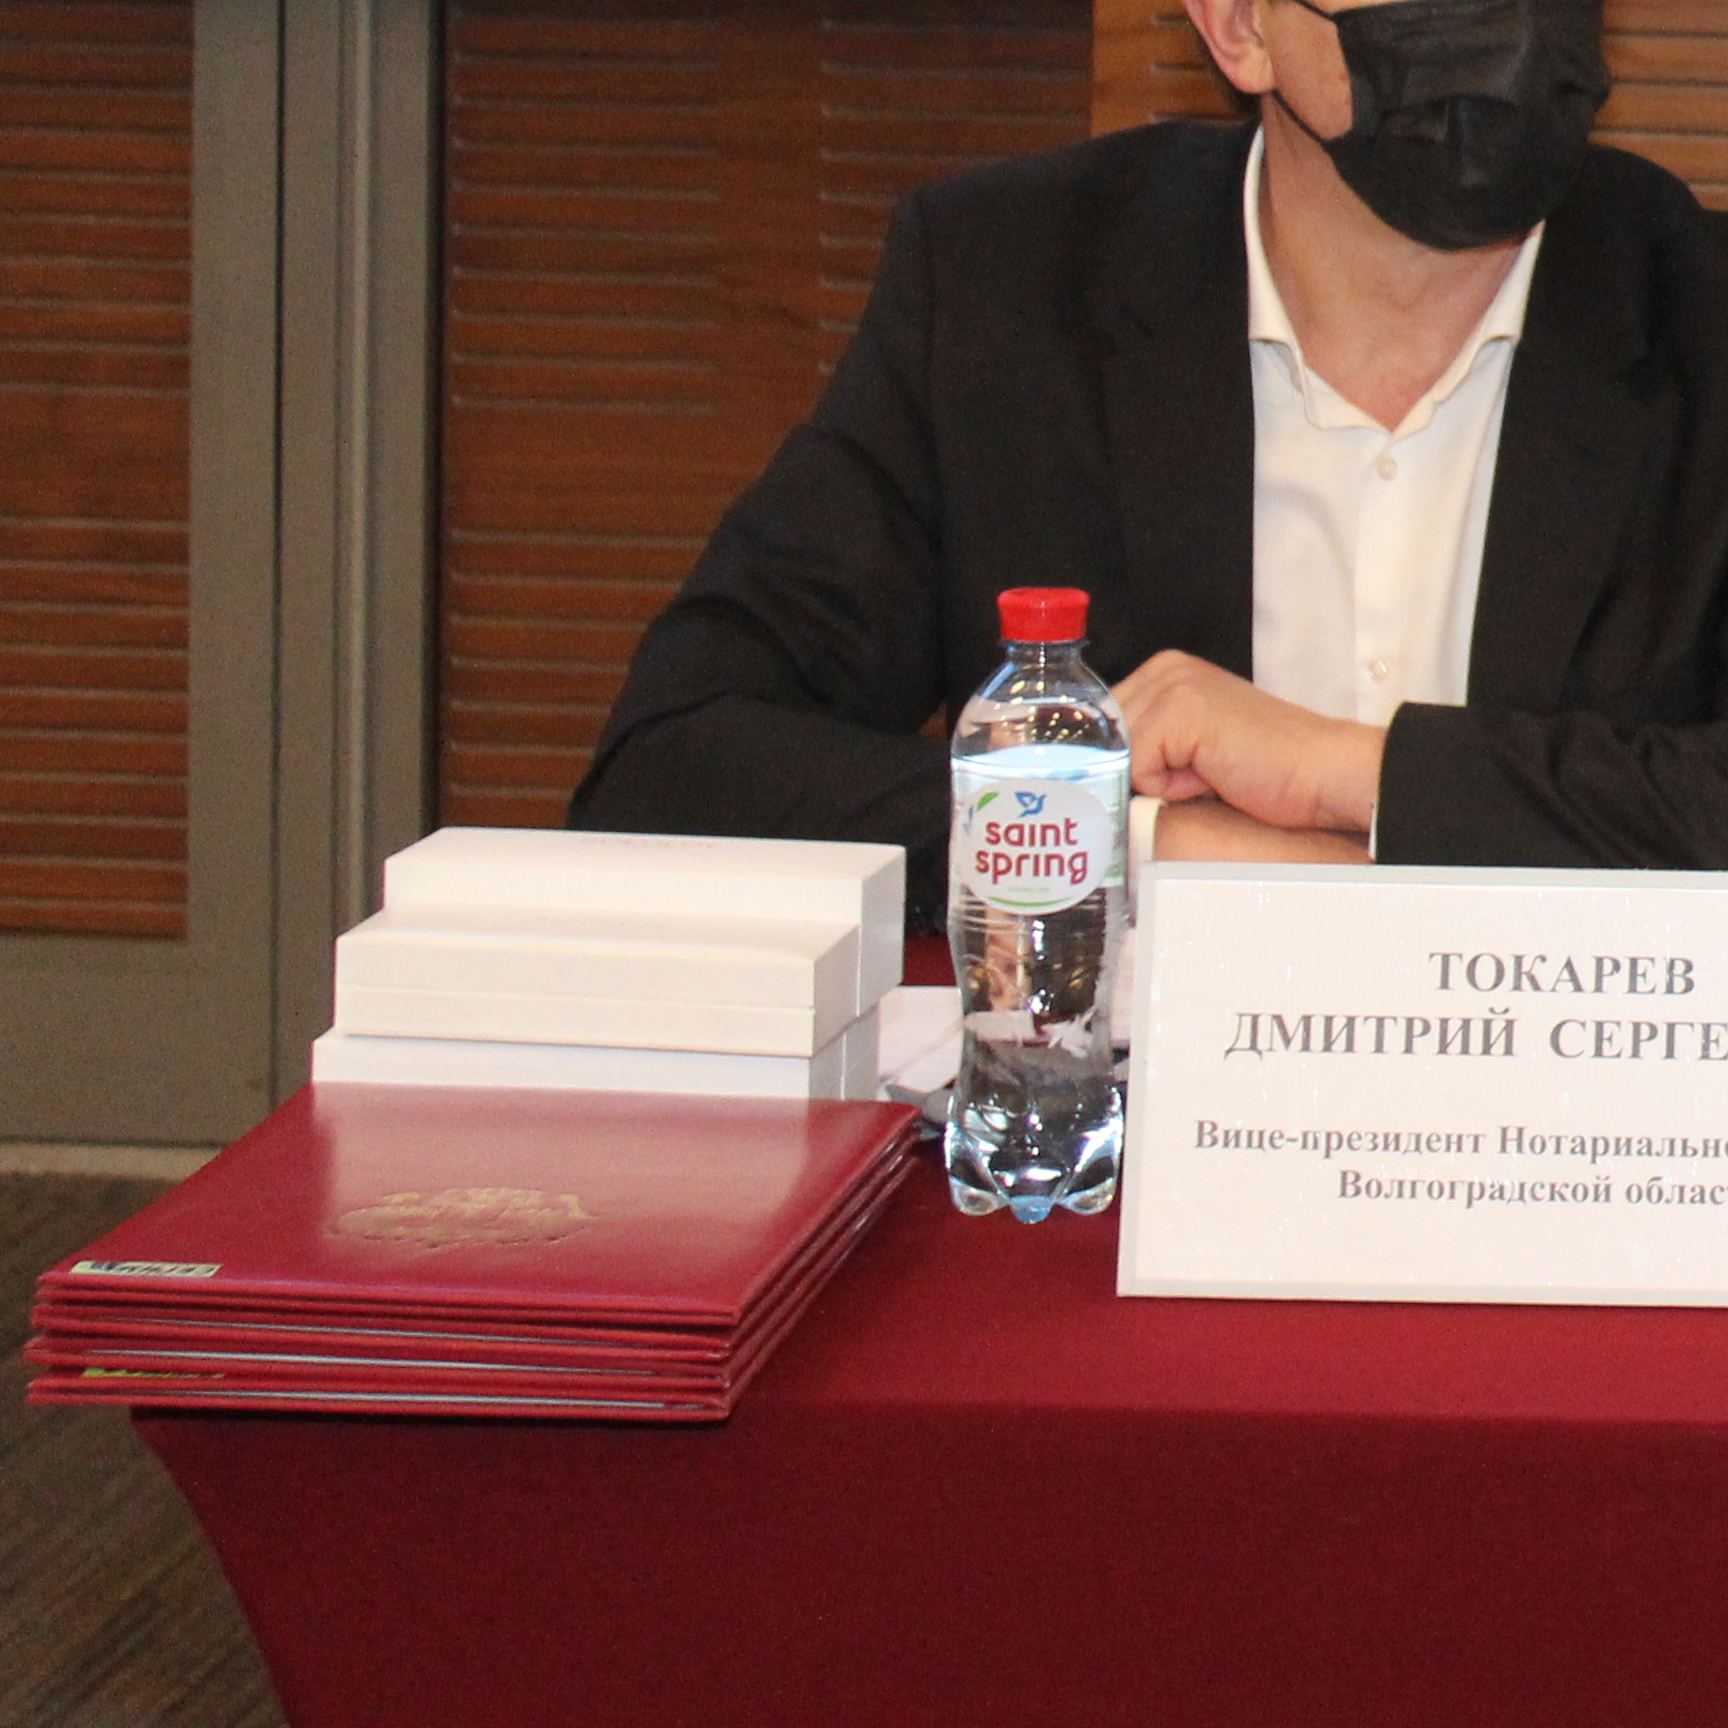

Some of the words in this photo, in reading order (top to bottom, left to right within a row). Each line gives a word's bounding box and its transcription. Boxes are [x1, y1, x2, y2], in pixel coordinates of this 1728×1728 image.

[985, 817, 1079, 847] saint
[975, 849, 1089, 885] spring
[1428, 951, 1696, 997] ТОКАРЕВ
[1223, 1006, 1518, 1060] ДМИТРИЙ
[1194, 1119, 1487, 1160] Вице-президент
[1337, 1168, 1613, 1209] Волгоградской
